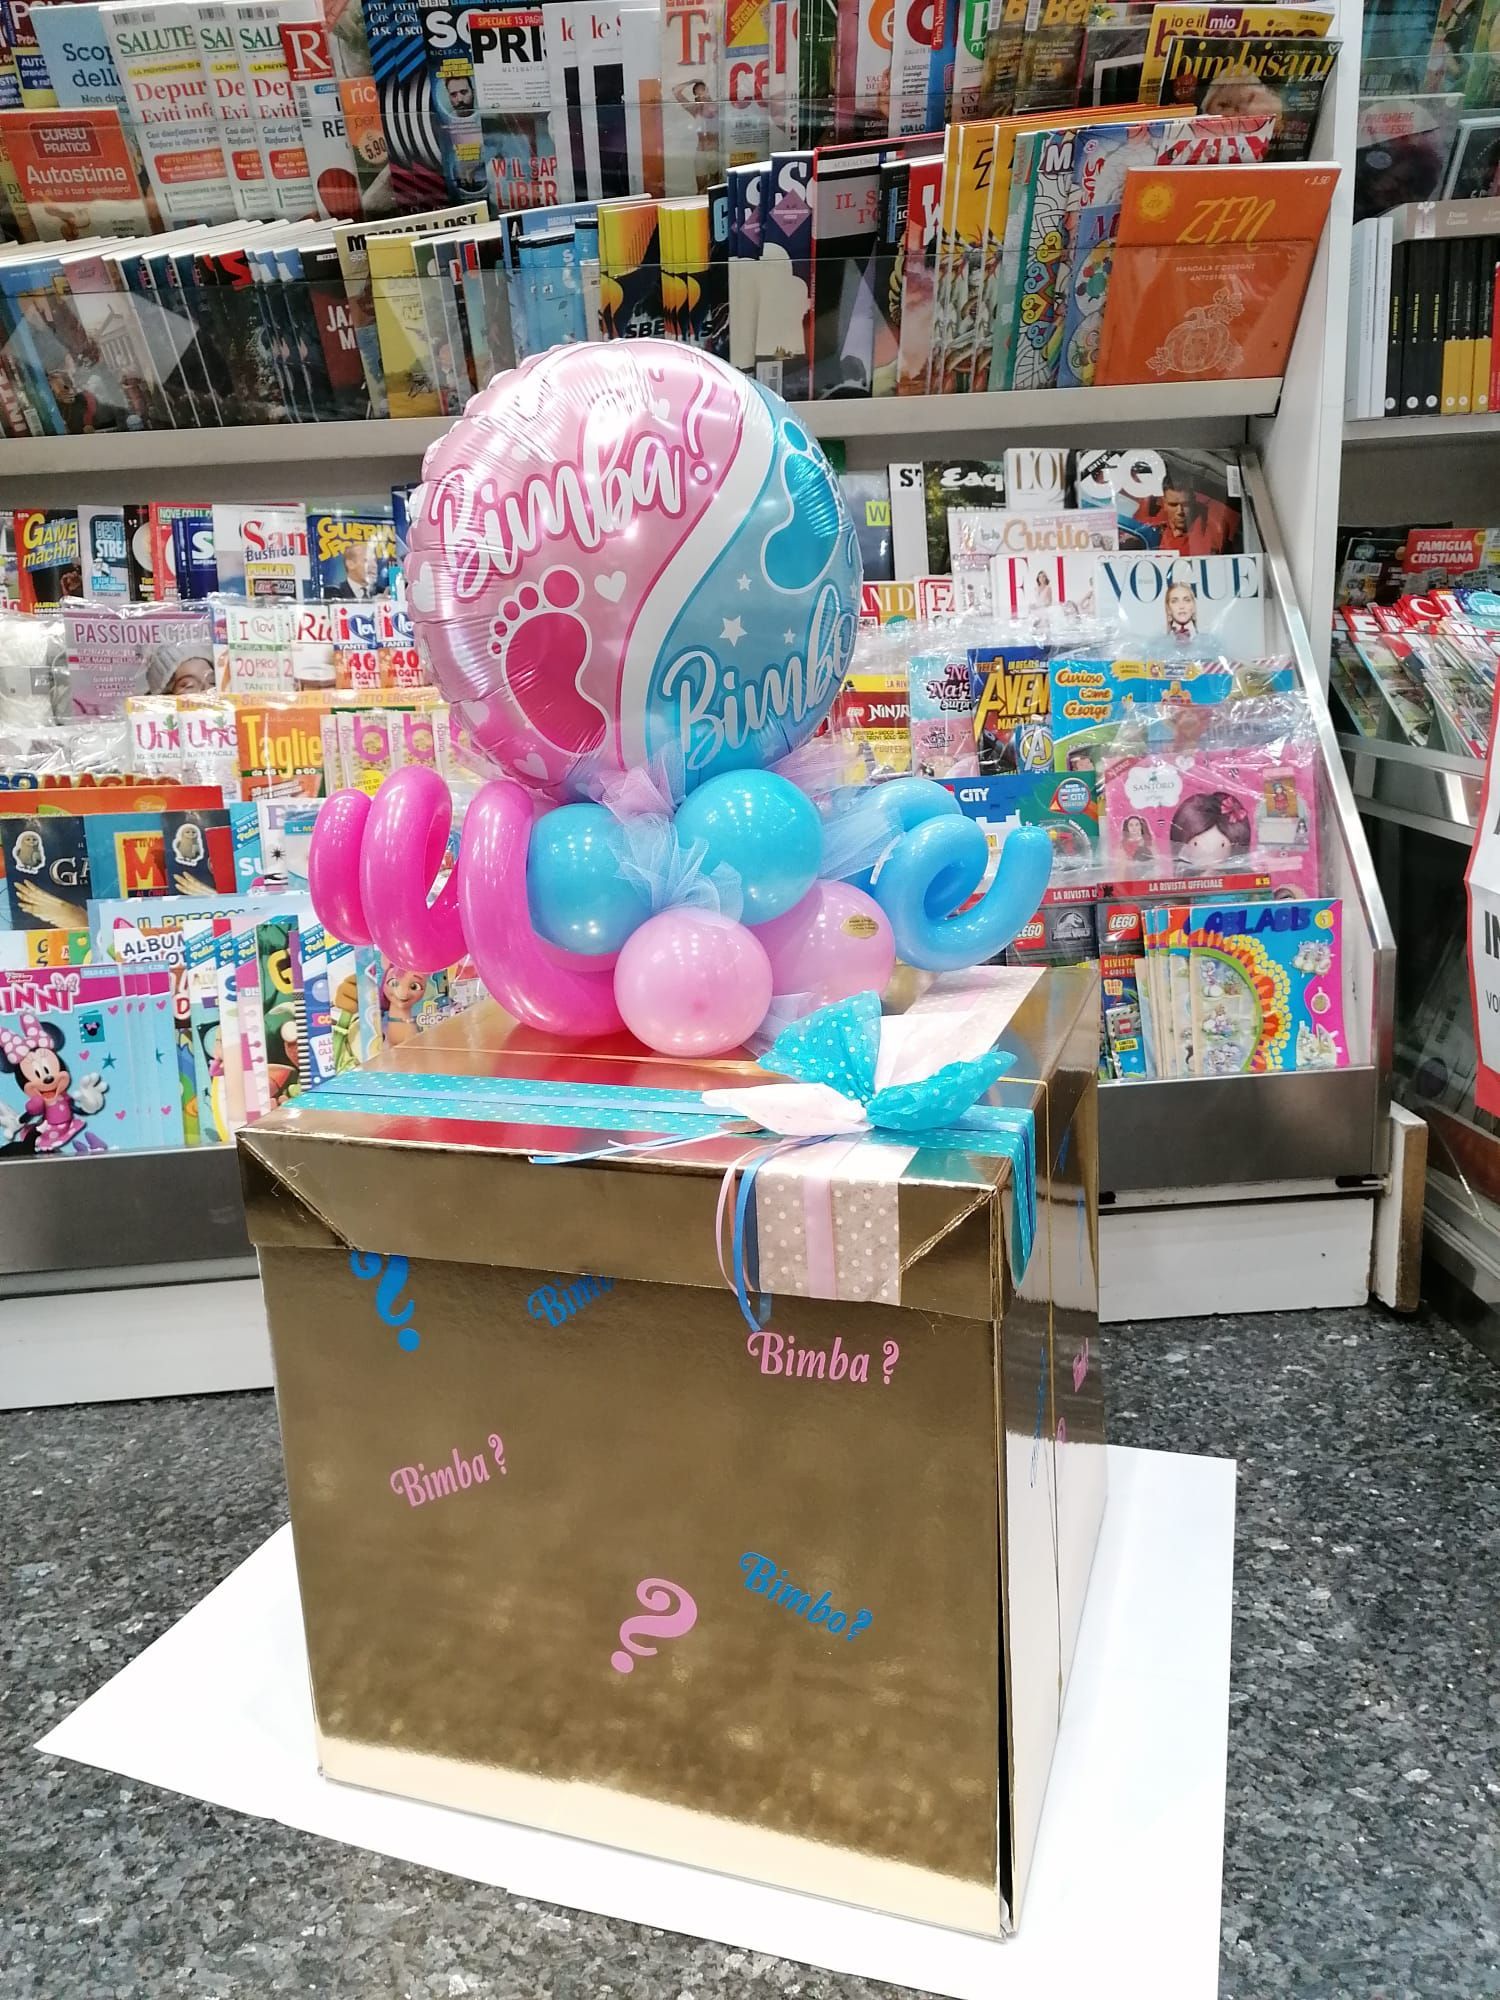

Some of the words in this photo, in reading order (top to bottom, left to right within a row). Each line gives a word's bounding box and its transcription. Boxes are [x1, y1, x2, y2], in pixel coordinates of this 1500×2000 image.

[478, 15, 512, 26] SPECIALE
[515, 14, 524, 24] 15
[1171, 14, 1184, 28] io
[1186, 18, 1194, 28] e
[1196, 14, 1205, 27] il
[1209, 15, 1236, 29] mio
[117, 26, 196, 54] SALUTE
[470, 27, 547, 64] PRI
[286, 29, 331, 72] R
[1170, 40, 1334, 80] bimbisani
[141, 103, 181, 123] Eviti
[43, 142, 91, 153] PRATICO
[364, 140, 387, 160] 5,90
[26, 163, 127, 185] Autostima
[495, 180, 558, 209] LIBER
[836, 194, 857, 210] IL
[433, 213, 478, 234] LOST
[1176, 196, 1276, 251] ZEN
[1176, 265, 1214, 273] MANDALA
[869, 505, 887, 521] W
[23, 513, 78, 549] GAME
[95, 521, 124, 540] BEST
[1003, 519, 1089, 551] Cucito
[245, 546, 295, 561] Bushido
[1417, 541, 1473, 552] FAMIGLIA
[1410, 552, 1475, 564] CRISTIANA
[1103, 556, 1259, 603] VOGUE
[75, 623, 161, 644] PASSIONE
[338, 643, 369, 651] TANTE
[382, 640, 411, 648] TANTE
[236, 657, 255, 677] 20
[391, 650, 420, 669] 40
[1056, 669, 1104, 686] Curioso
[1064, 703, 1111, 720] George
[241, 715, 322, 779] Taglie
[1133, 781, 1175, 792] SANTORO
[1053, 889, 1062, 900] LA
[1063, 888, 1092, 900] RIVISTA
[1149, 882, 1158, 892] LA
[1160, 880, 1187, 891] RIVISTA
[1188, 879, 1223, 890] UFFICIALE
[1017, 923, 1042, 937] EGO
[1110, 914, 1138, 929] LEGO
[0, 985, 73, 1014] INNI
[746, 1330, 870, 1382] Bimba
[390, 1448, 490, 1507] Bimba
